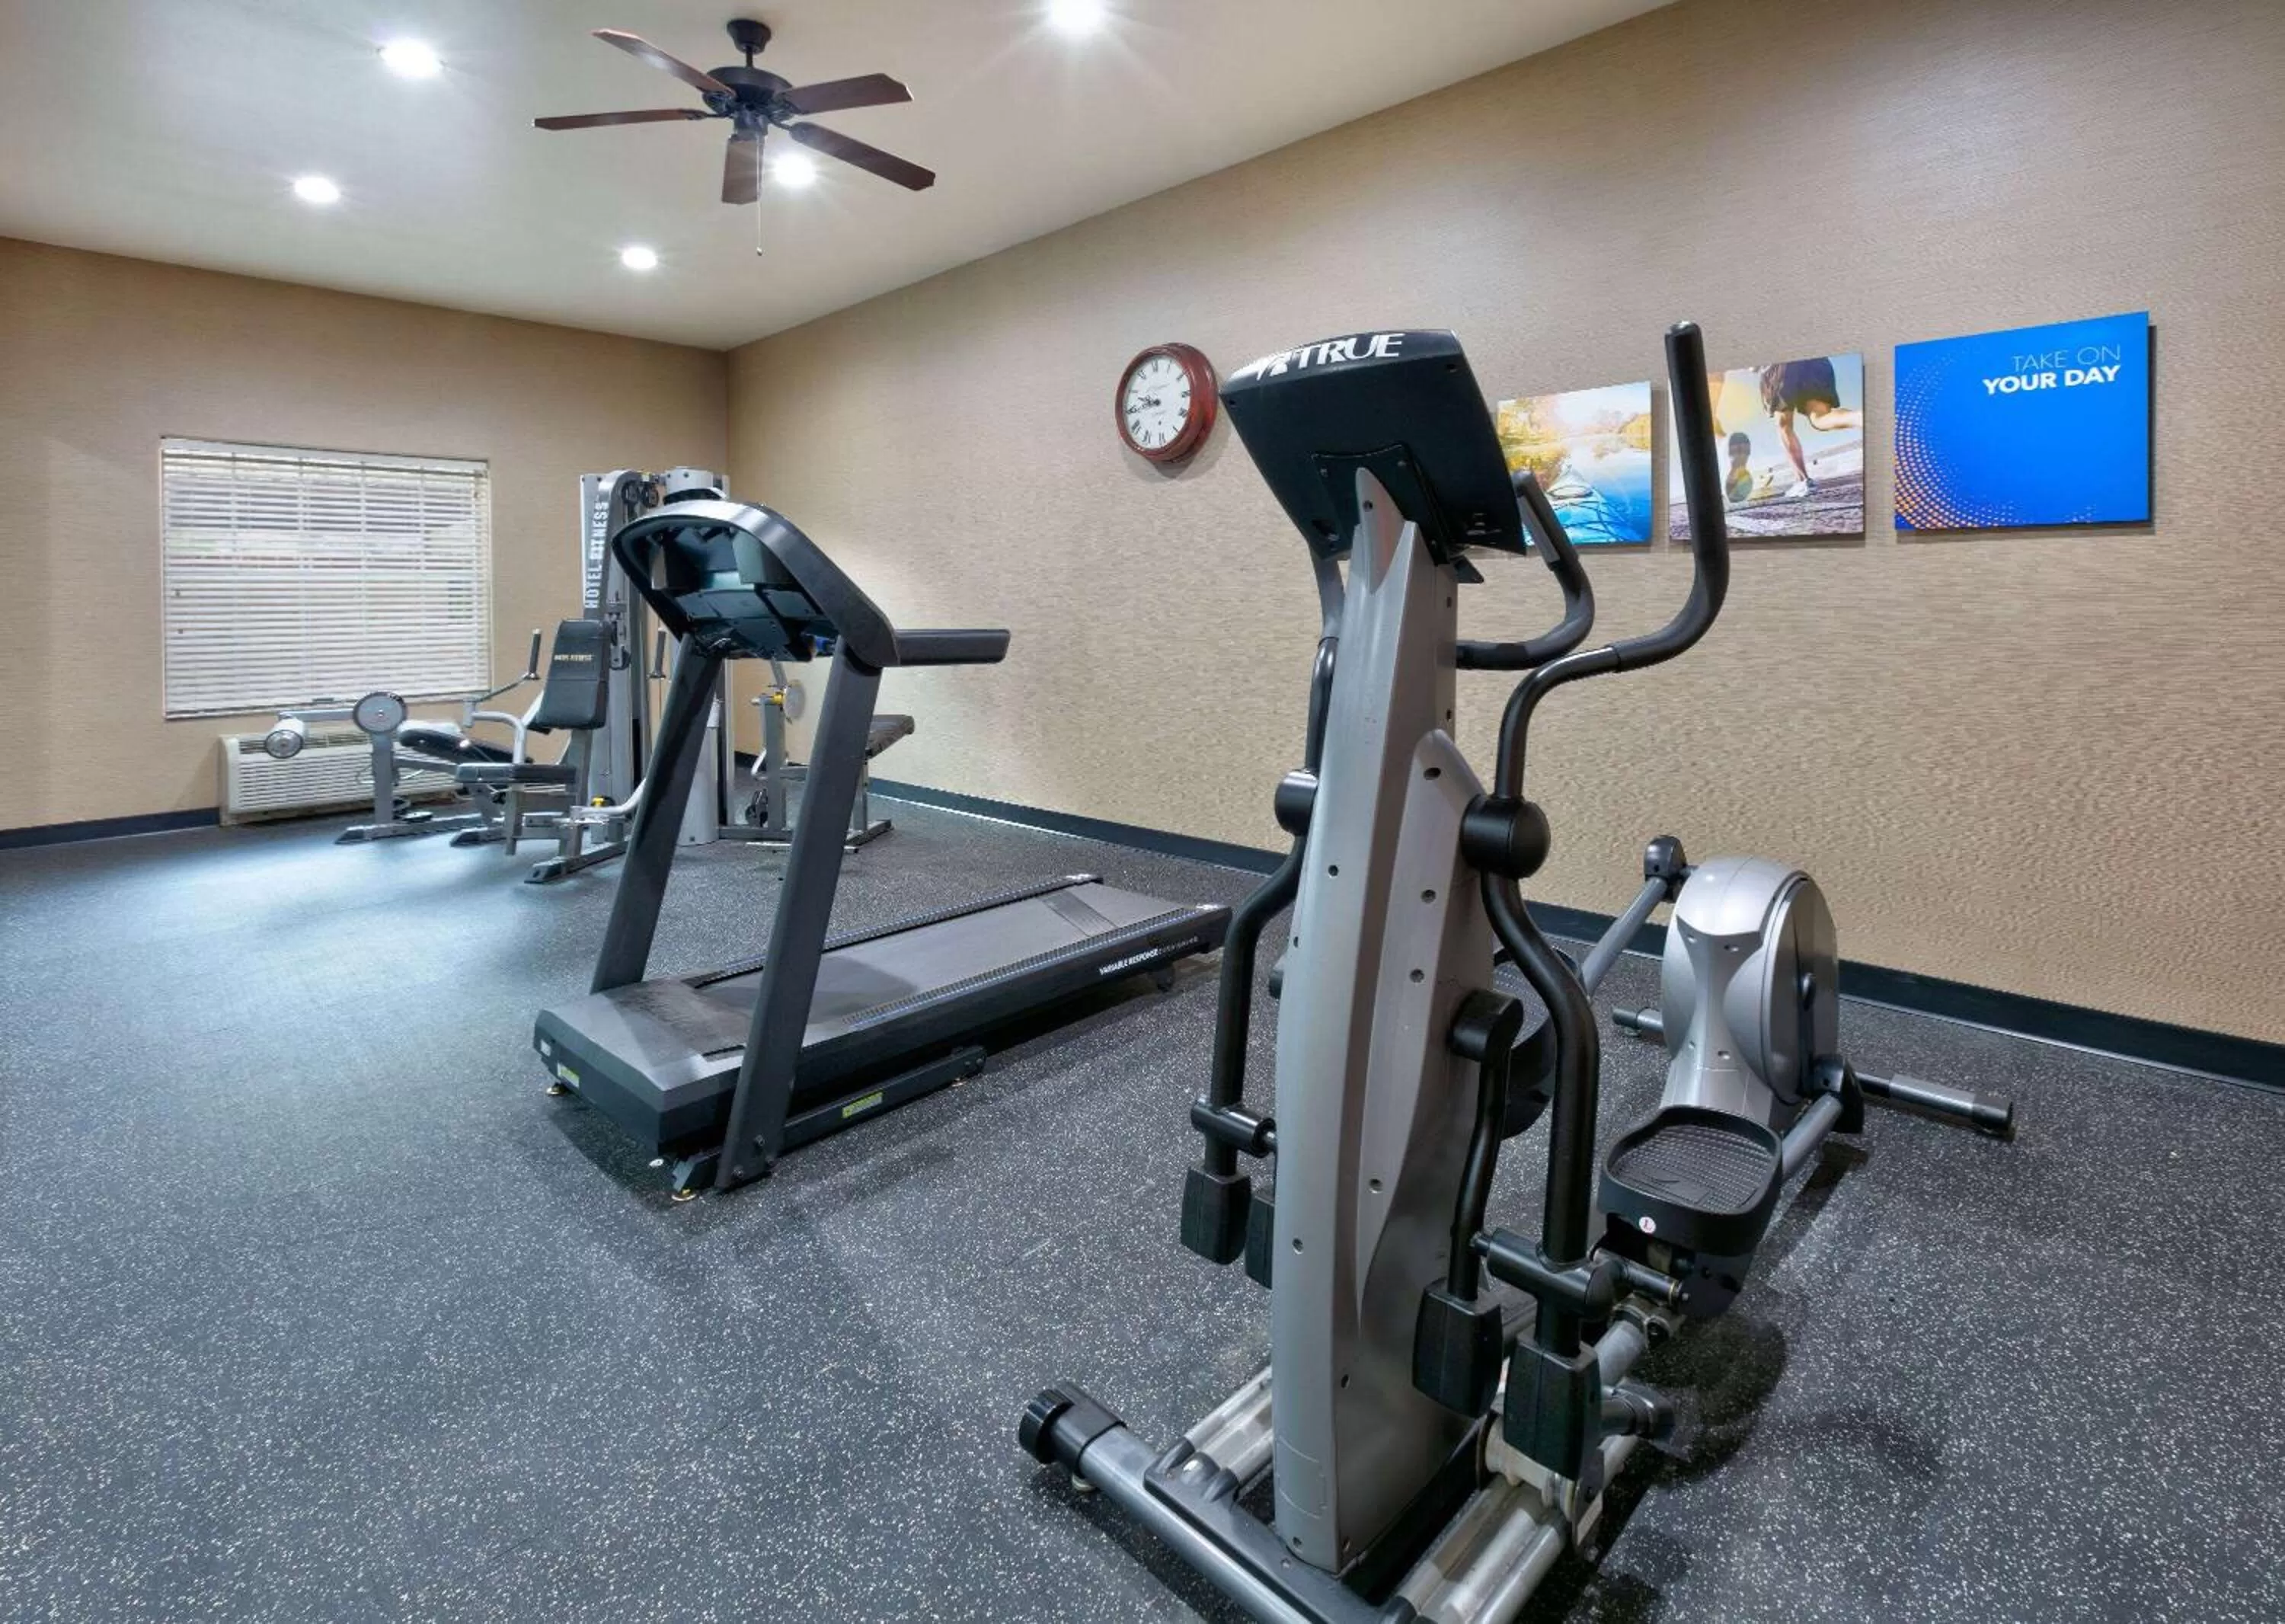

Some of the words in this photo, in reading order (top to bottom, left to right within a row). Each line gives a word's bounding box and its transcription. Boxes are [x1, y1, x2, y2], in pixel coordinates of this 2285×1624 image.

[1297, 333, 1405, 369] TRUE
[2012, 350, 2069, 372] TAKE
[2077, 344, 2121, 365] ON
[1983, 372, 2057, 395] YOUR
[2065, 365, 2121, 387] DAY
[590, 502, 609, 560] FITNESS
[585, 564, 602, 609] HOTEL
